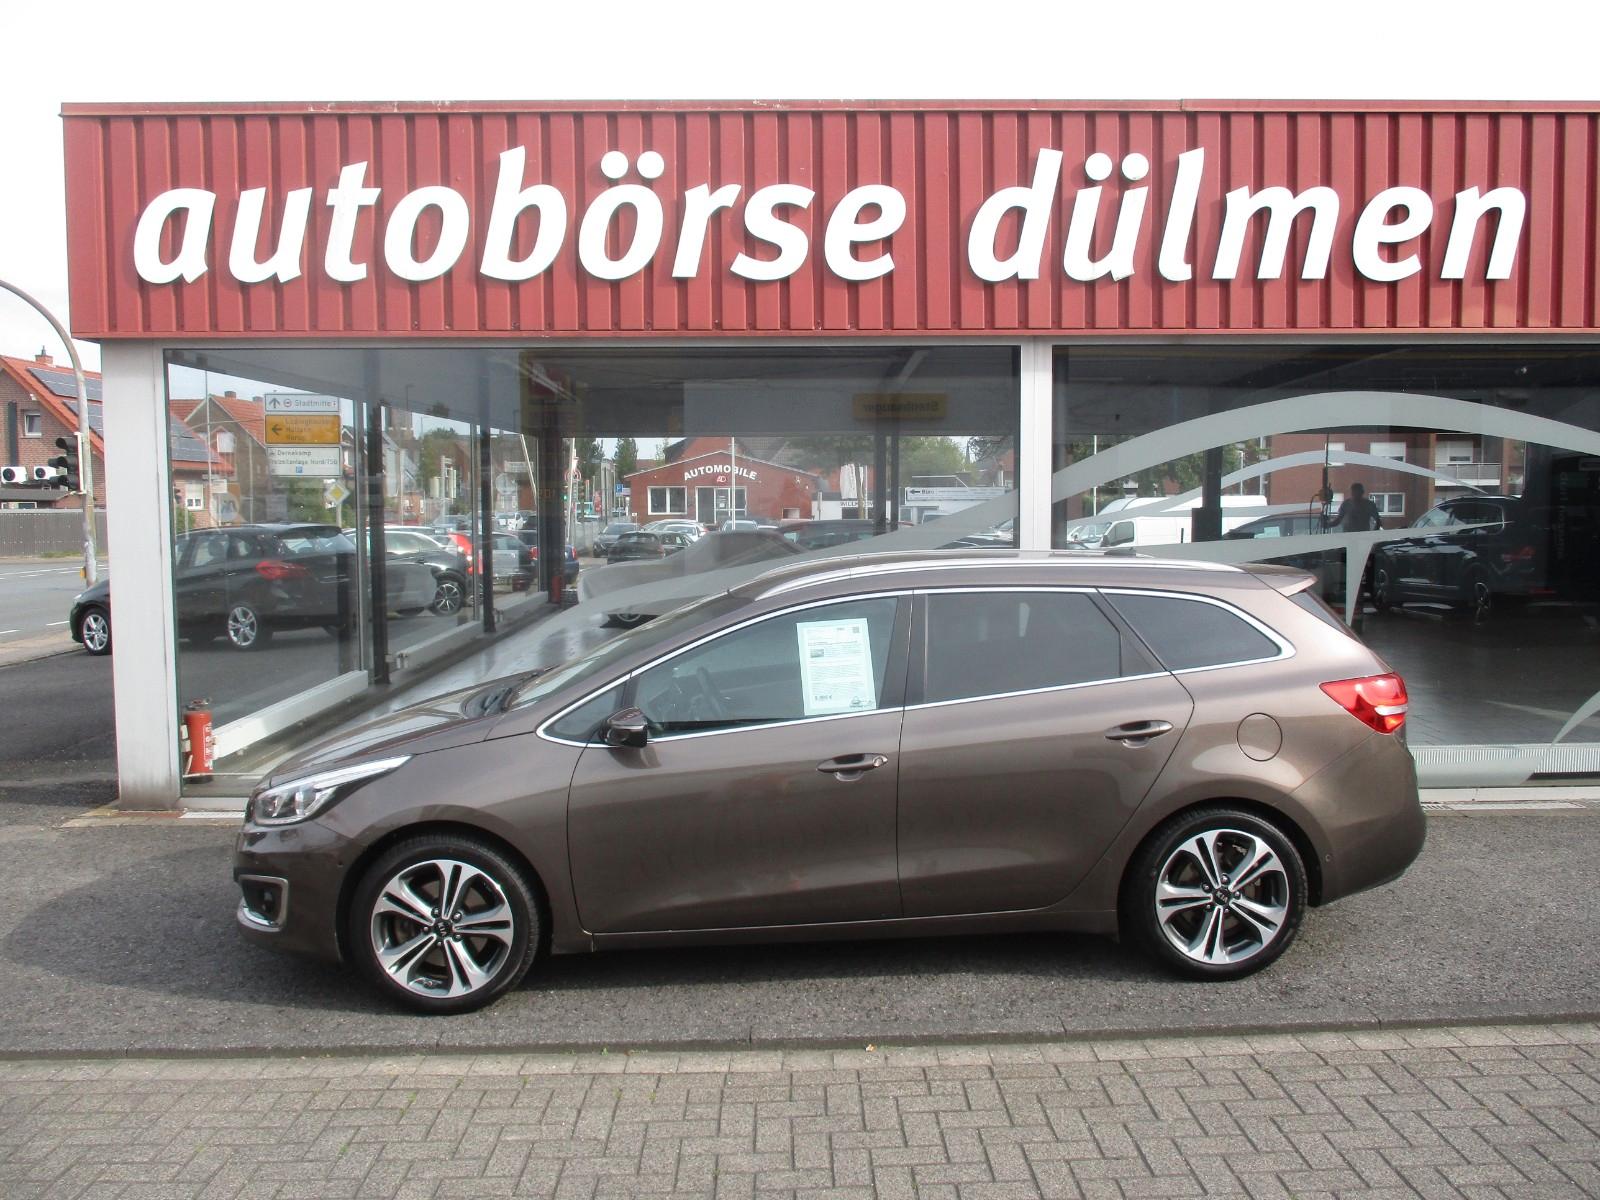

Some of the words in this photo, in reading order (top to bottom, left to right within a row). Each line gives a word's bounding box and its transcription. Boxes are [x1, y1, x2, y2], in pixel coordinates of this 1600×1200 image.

[133, 145, 907, 284] autobörse
[967, 146, 1526, 282] dülmen
[684, 464, 758, 480] AUTOMOBILE
